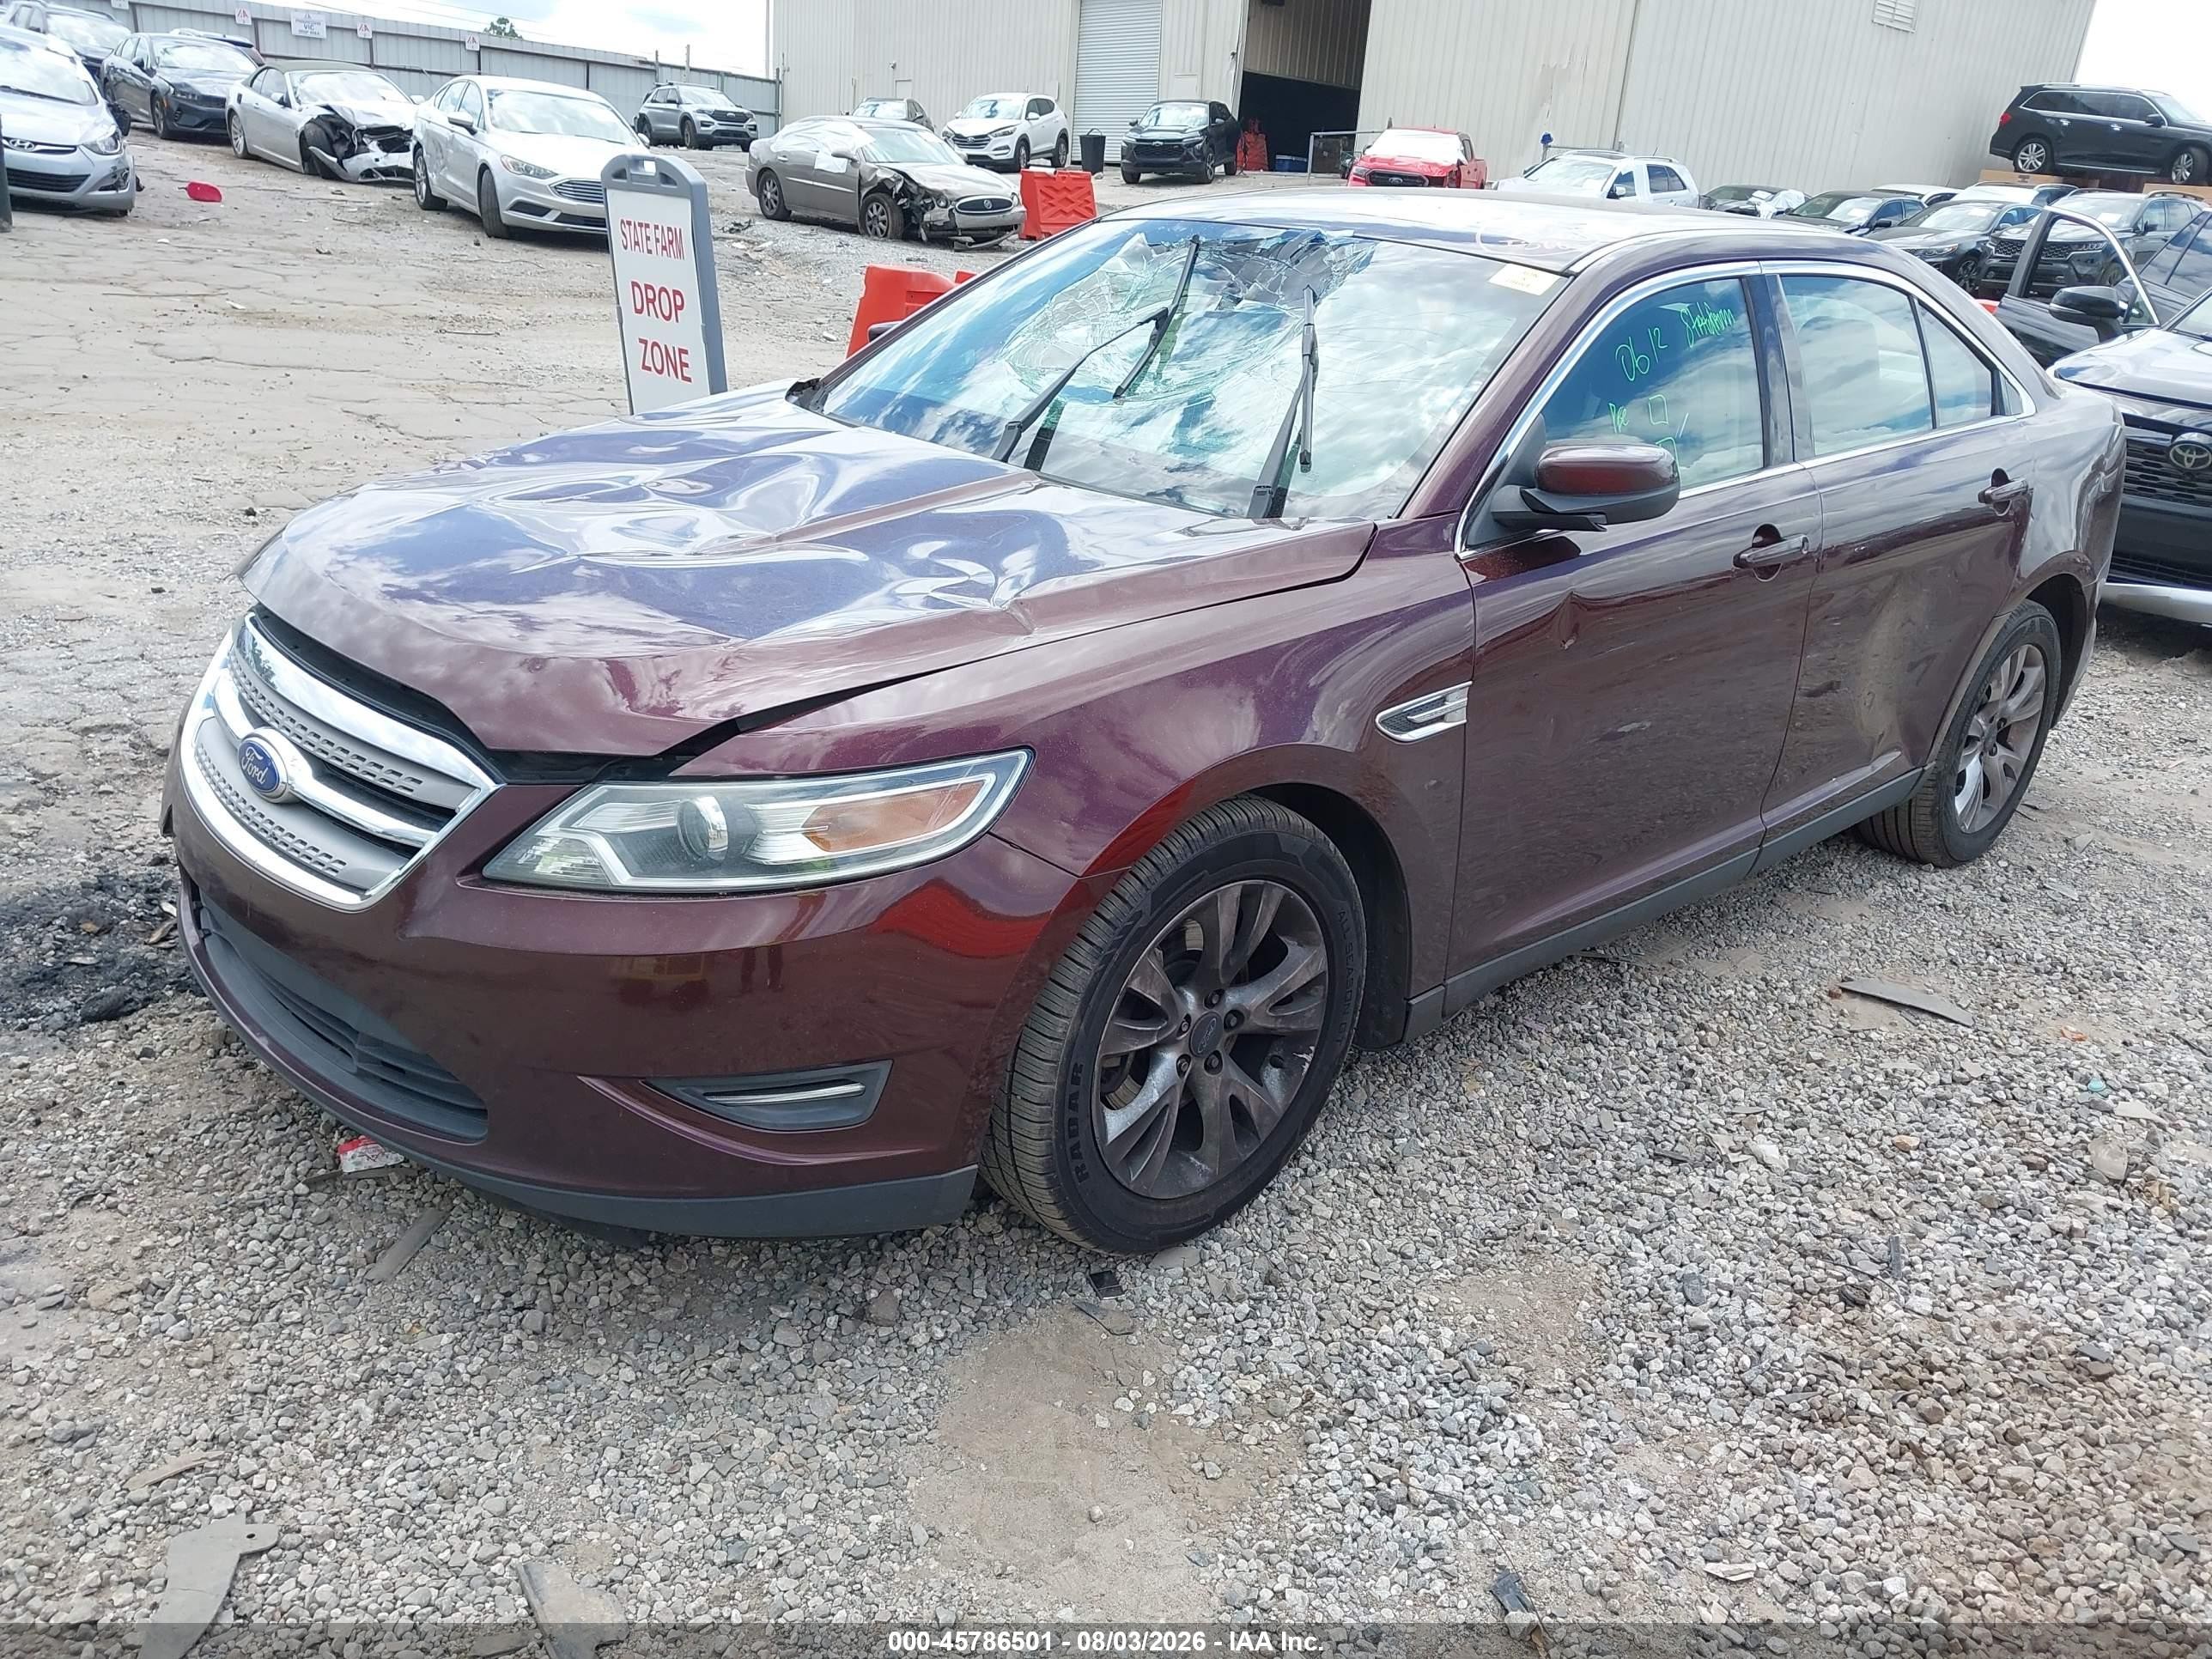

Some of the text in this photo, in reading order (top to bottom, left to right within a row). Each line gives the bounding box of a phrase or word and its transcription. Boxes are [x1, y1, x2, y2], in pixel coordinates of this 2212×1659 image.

[620, 218, 685, 260] STATE FARM
[630, 280, 685, 324] DROP
[638, 337, 692, 383] ZONE
[241, 745, 269, 785] Ford
[1337, 908, 1351, 940] ALL
[1342, 943, 1354, 1015] SEASON
[1067, 1061, 1090, 1183] RADAR
